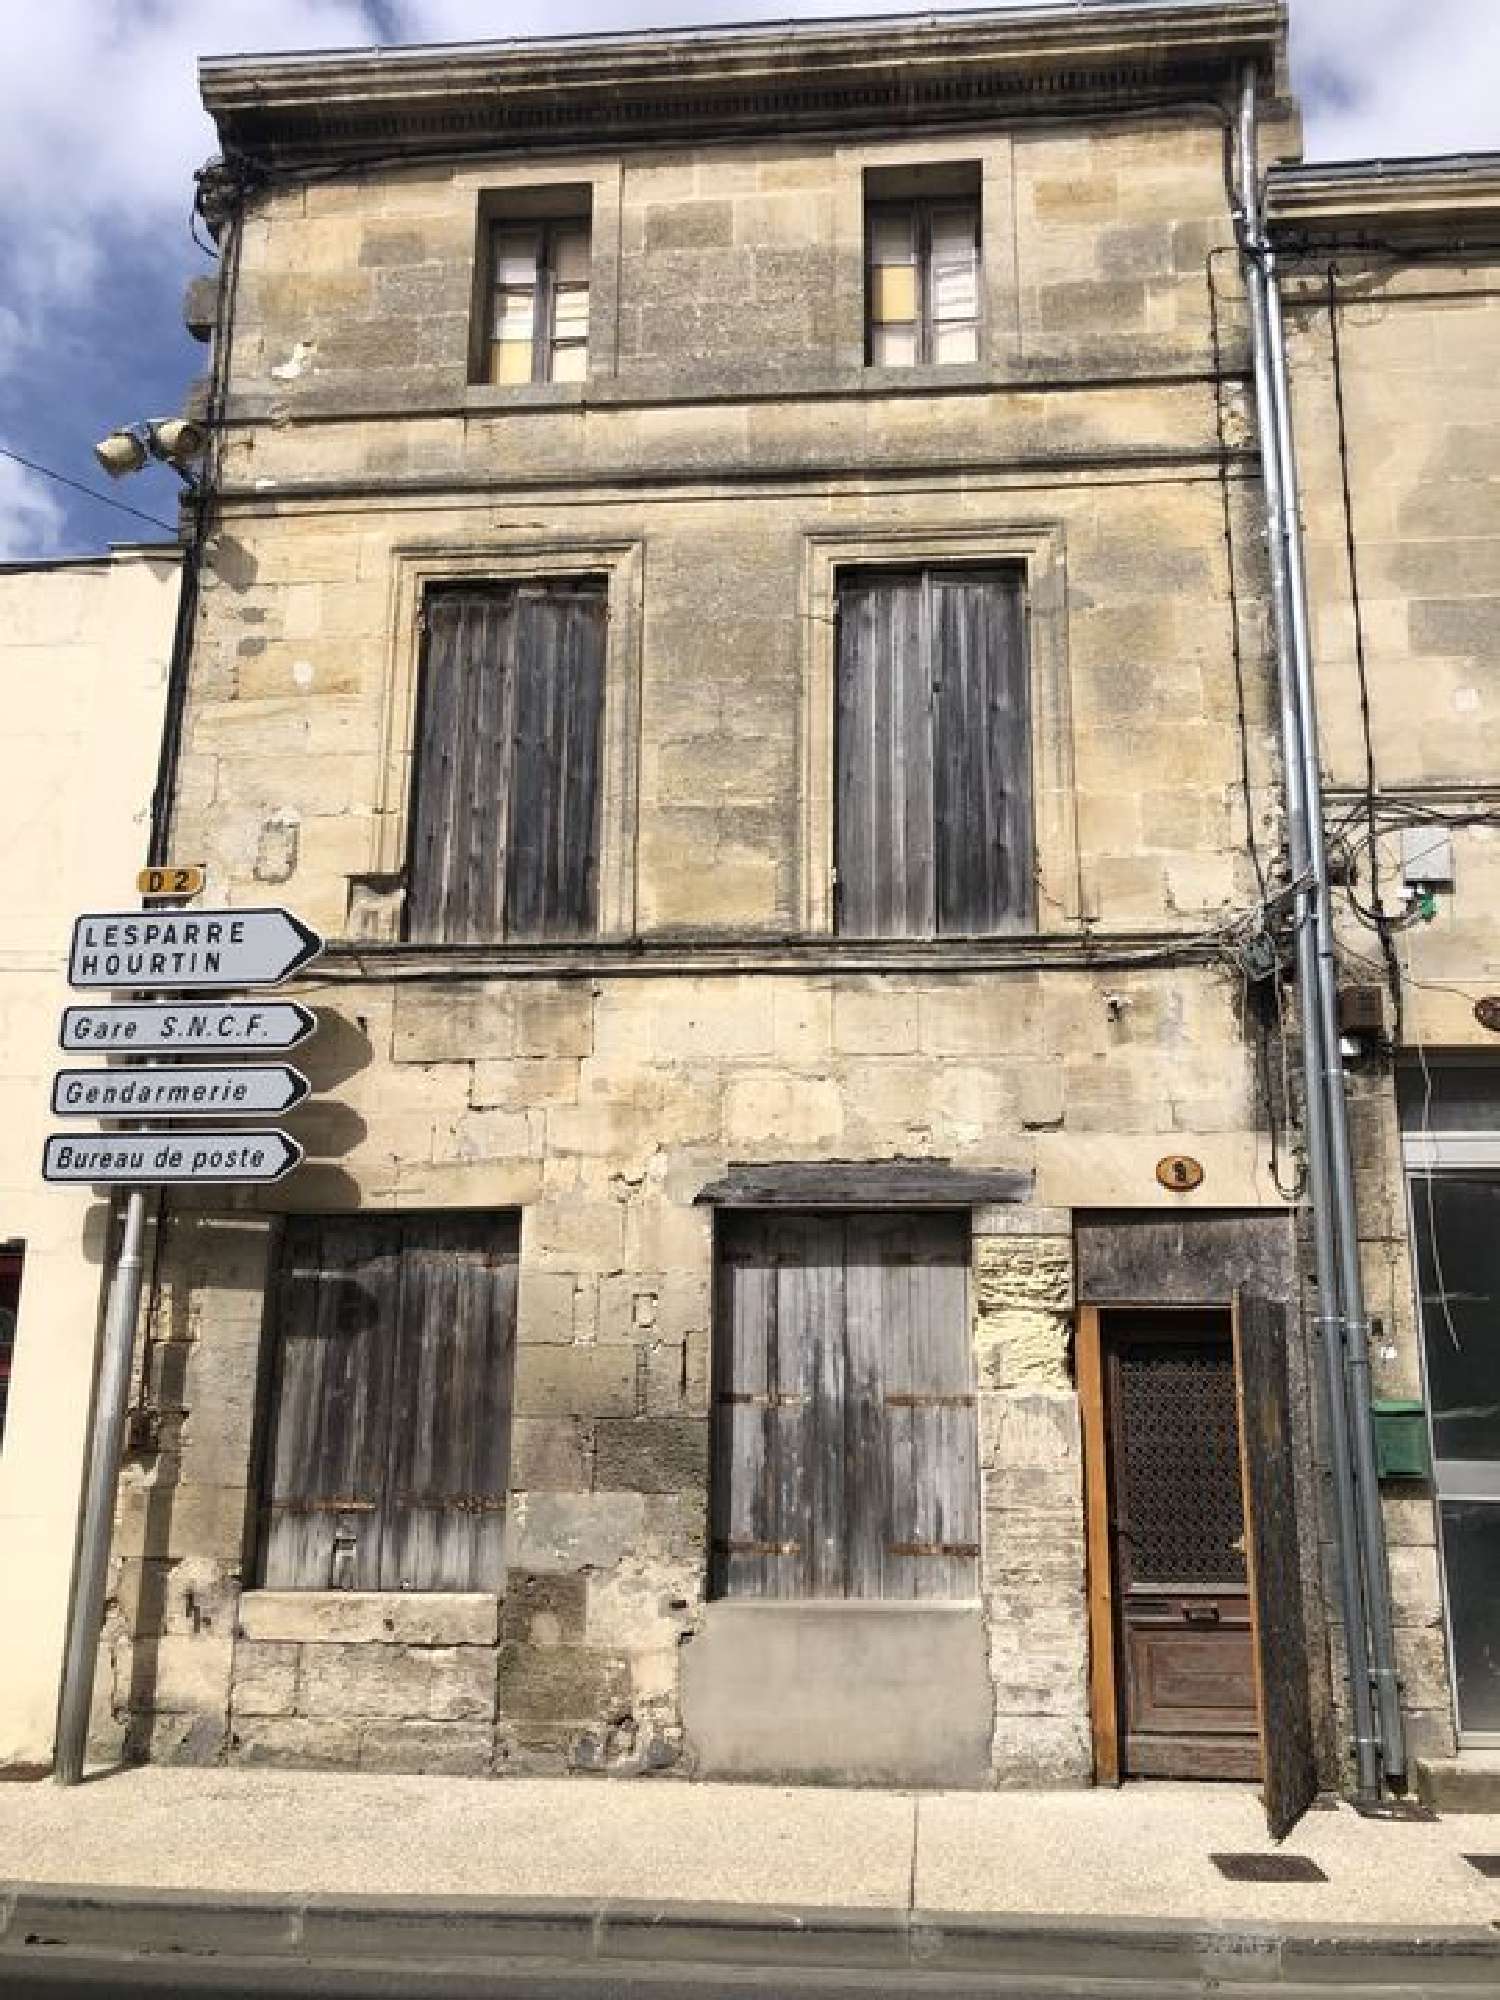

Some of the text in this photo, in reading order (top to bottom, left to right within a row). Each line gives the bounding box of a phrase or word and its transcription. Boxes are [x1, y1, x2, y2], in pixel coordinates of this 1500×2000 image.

[174, 870, 190, 892] 2
[85, 921, 245, 948] LESPARRE
[81, 951, 221, 976] HOURTIN
[73, 1014, 268, 1040] Gare S.N.C.F.
[66, 1079, 248, 1104] Gendarmerie
[56, 1144, 265, 1173] Bureau de poste
